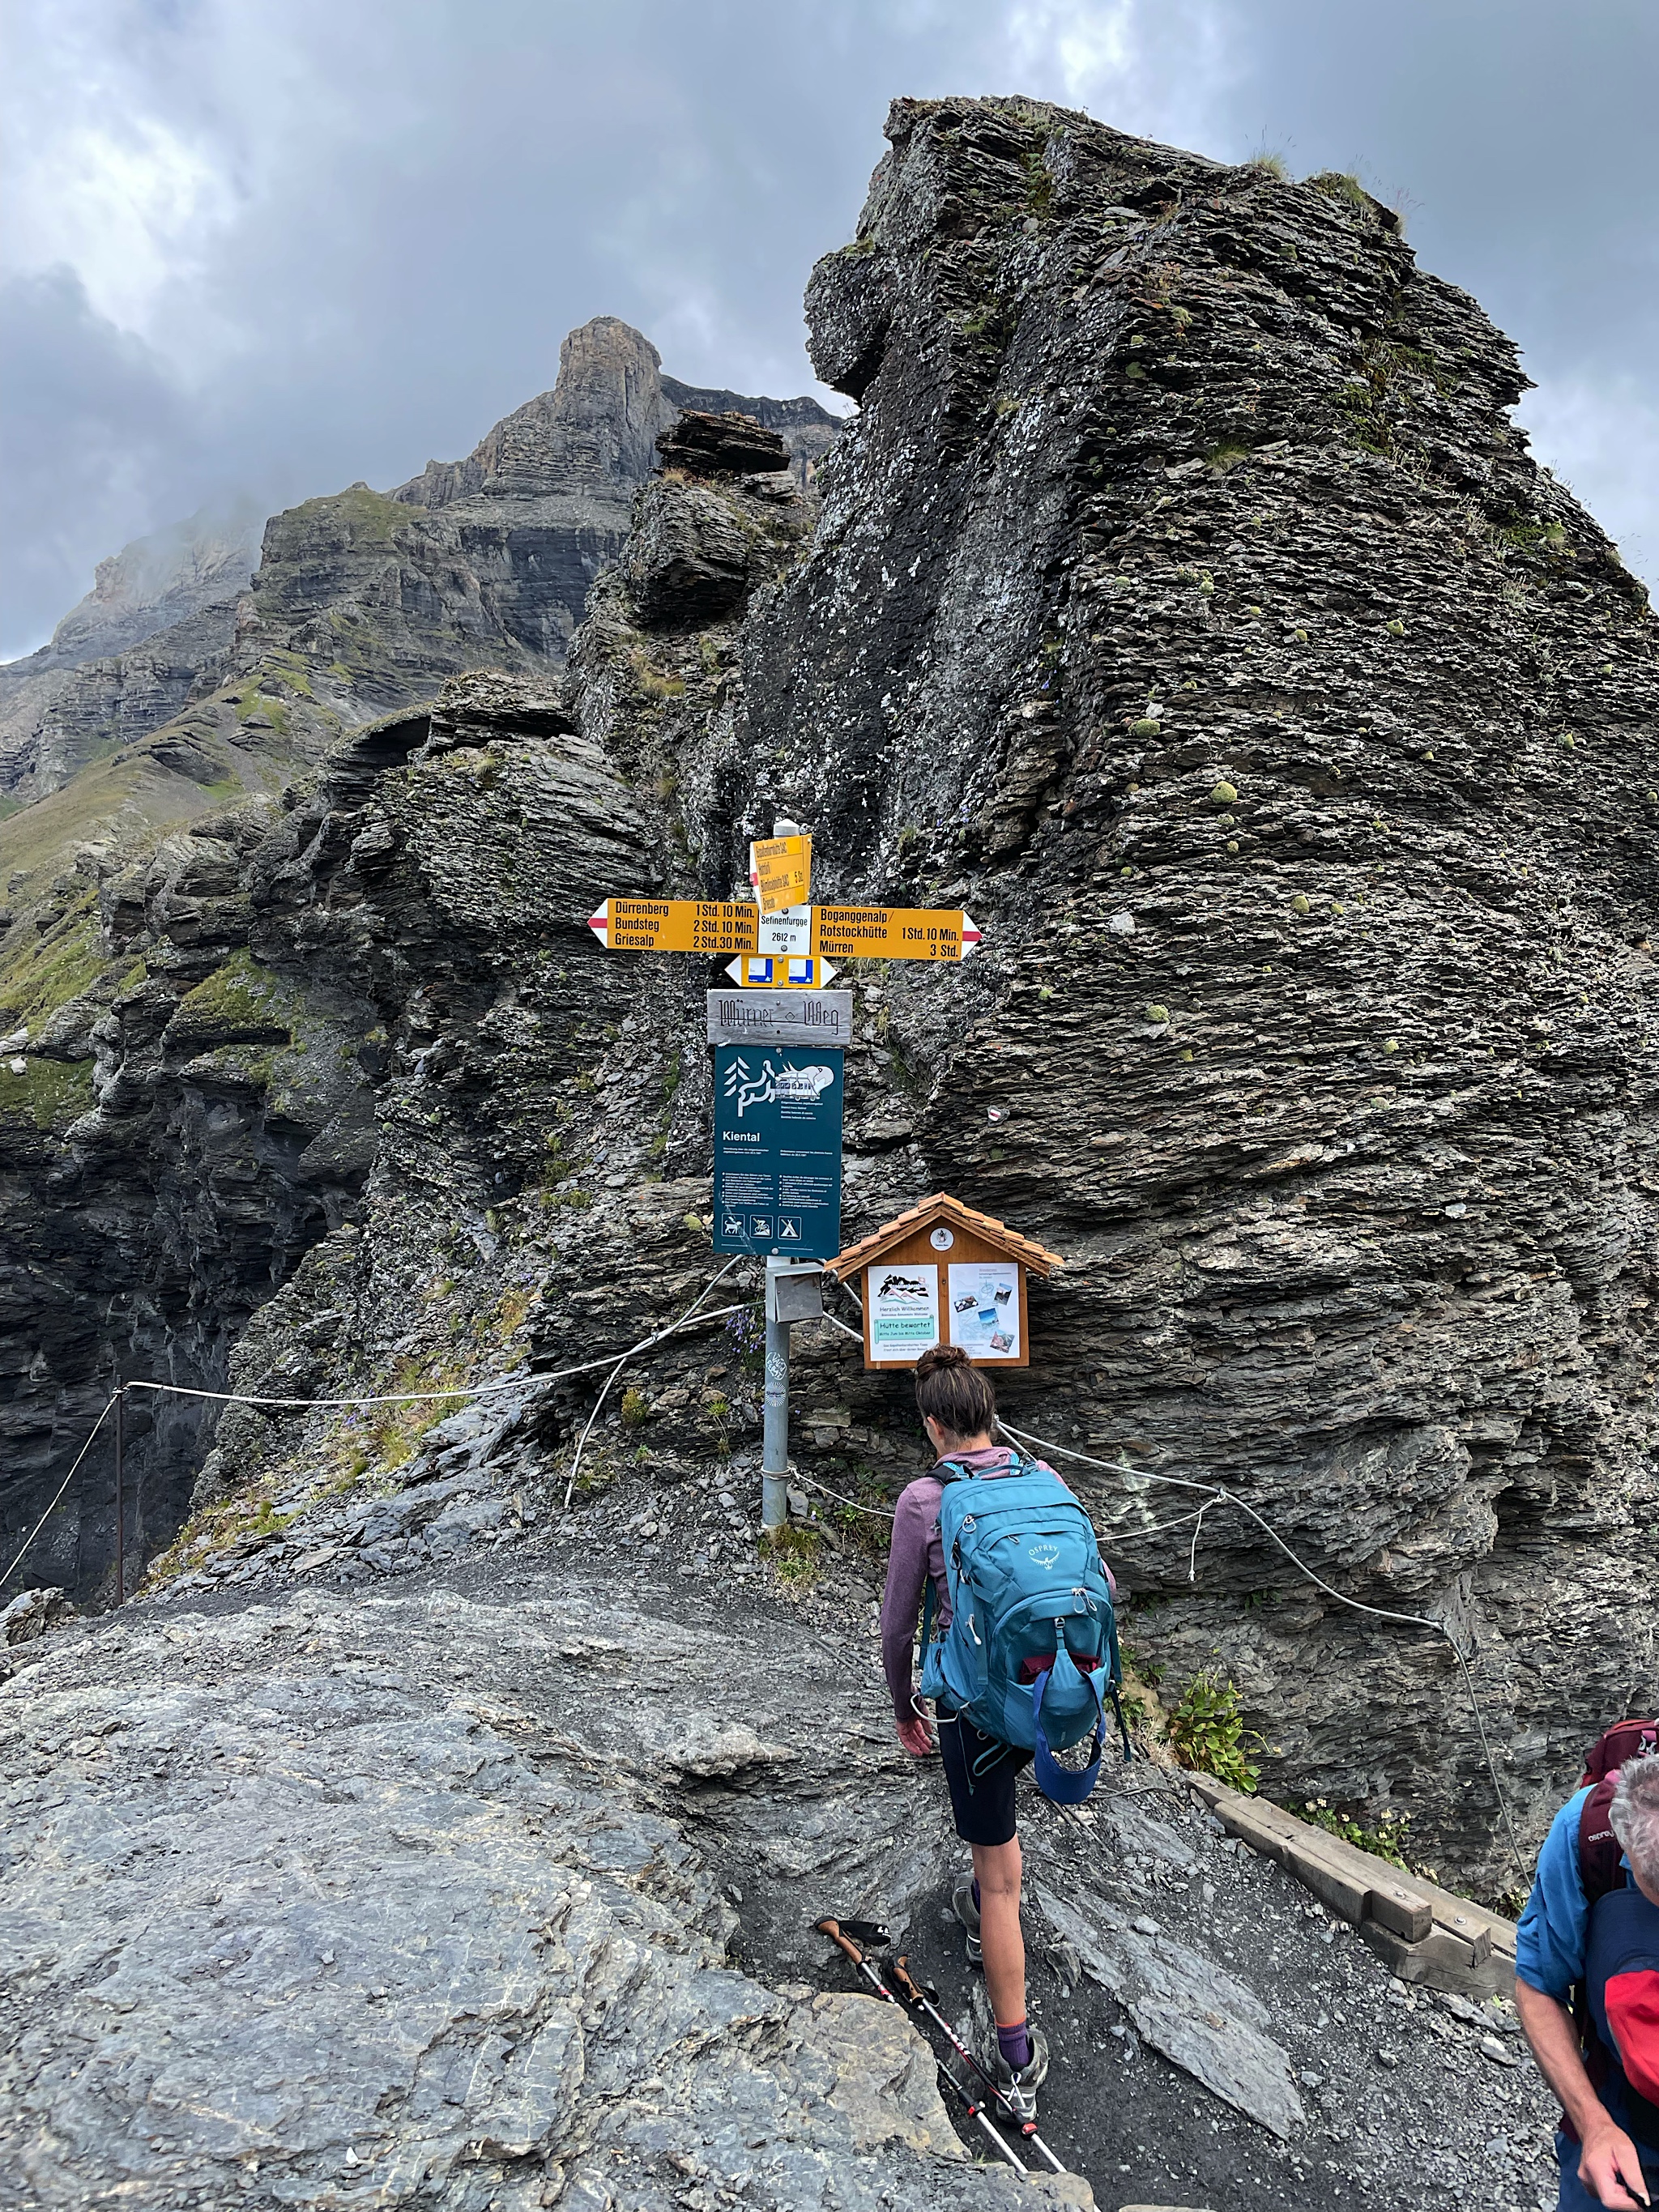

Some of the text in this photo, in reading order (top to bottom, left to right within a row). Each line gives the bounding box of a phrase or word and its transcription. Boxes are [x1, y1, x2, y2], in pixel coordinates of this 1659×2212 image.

[794, 872, 798, 883] 5
[615, 901, 755, 918] Dürrenberg 1 Std. 10 Min.
[615, 917, 754, 934] Bundsteg 2 Std. 10 Min.
[761, 915, 808, 927] Sefinenfurgge
[771, 932, 788, 942] 2612
[820, 924, 888, 939] Rotstockhütte
[939, 928, 959, 941] Min.
[615, 933, 655, 948] Griesalp
[693, 936, 699, 948] 2
[734, 937, 754, 950] Min.
[819, 940, 959, 957] Mürren 3 Std.
[803, 1000, 839, 1036] Weg
[723, 1131, 761, 1142] Kiental
[1028, 1544, 1058, 1556] OSPREY
